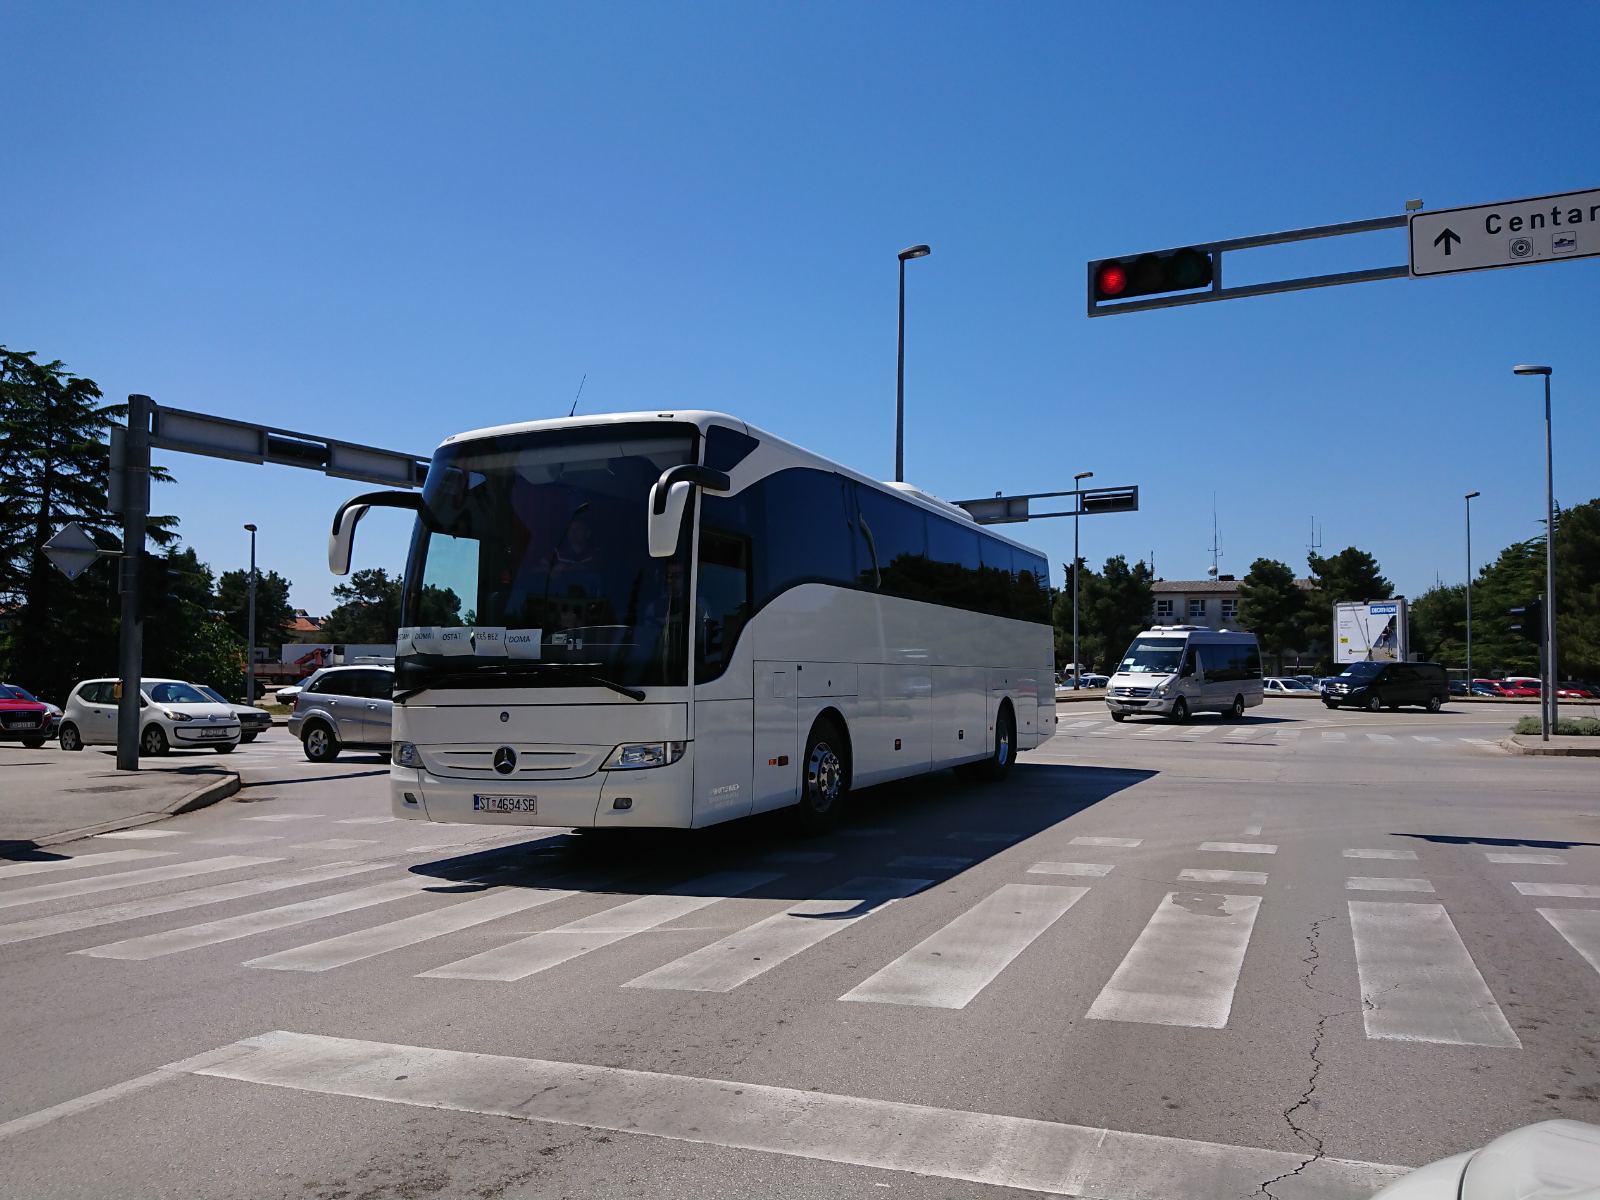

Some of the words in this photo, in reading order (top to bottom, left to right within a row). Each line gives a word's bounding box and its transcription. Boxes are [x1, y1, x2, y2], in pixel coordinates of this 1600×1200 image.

[1486, 205, 1600, 235] Centar
[442, 633, 461, 641] OSTAT
[509, 635, 531, 643] DOMA
[480, 797, 491, 810] ST
